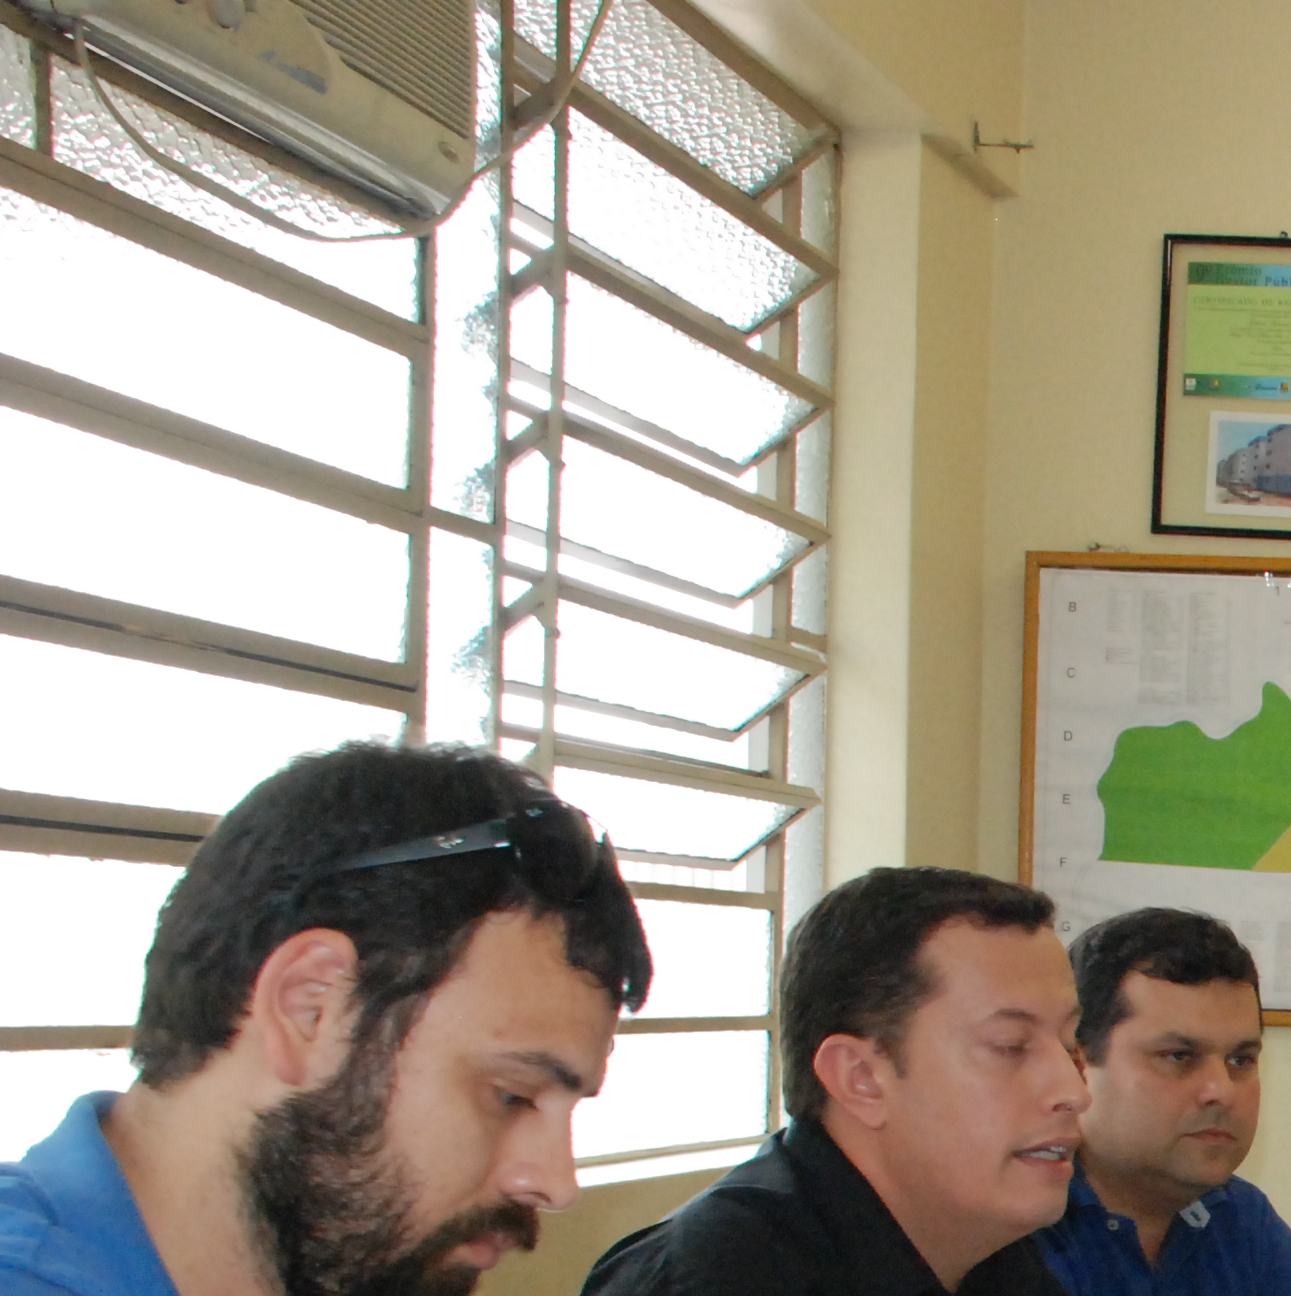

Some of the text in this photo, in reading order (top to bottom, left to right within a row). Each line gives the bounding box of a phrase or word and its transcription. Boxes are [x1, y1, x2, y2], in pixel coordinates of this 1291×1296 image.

[1275, 586, 1280, 596] 1
[1068, 602, 1077, 613] B
[1066, 667, 1076, 679] C
[1063, 731, 1073, 742] D
[1062, 794, 1070, 805] E
[1059, 857, 1067, 868] F
[1061, 921, 1071, 933] G
